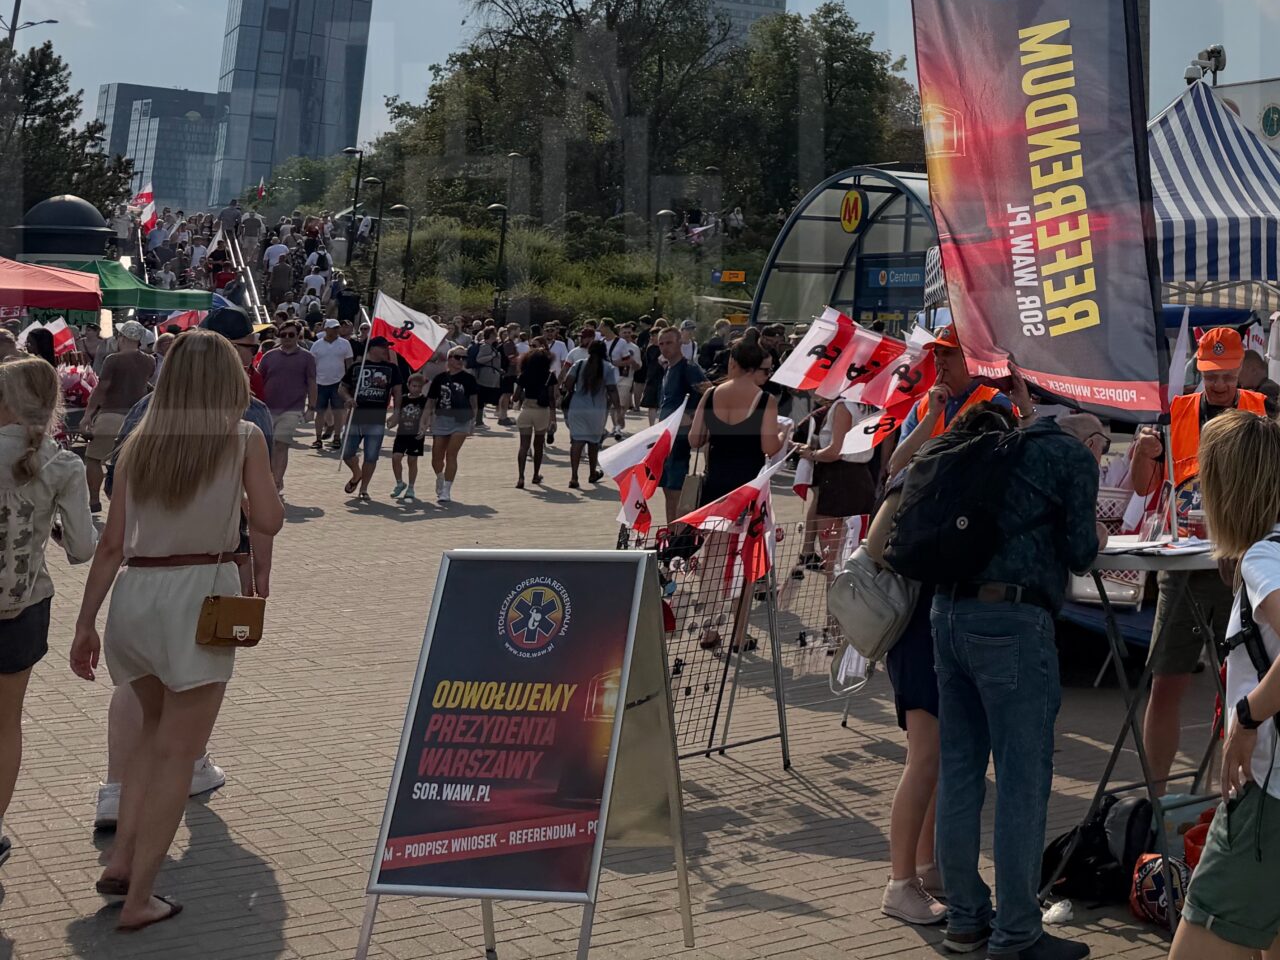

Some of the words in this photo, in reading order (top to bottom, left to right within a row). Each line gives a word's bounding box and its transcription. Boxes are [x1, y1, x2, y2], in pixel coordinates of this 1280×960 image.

[889, 271, 921, 282] Centrum
[515, 576, 552, 592] OPERACJA
[551, 580, 572, 636] REFERENDALNA
[431, 679, 578, 712] ODWOŁUJEMY
[423, 713, 558, 746] PREZYDENTA
[418, 747, 545, 780] WARSZAWY
[412, 782, 491, 802] SOR.WAW.PL
[404, 838, 448, 859] PODPISZ
[451, 832, 498, 853] WNIOSEK
[509, 822, 576, 845] REFERENDUM
